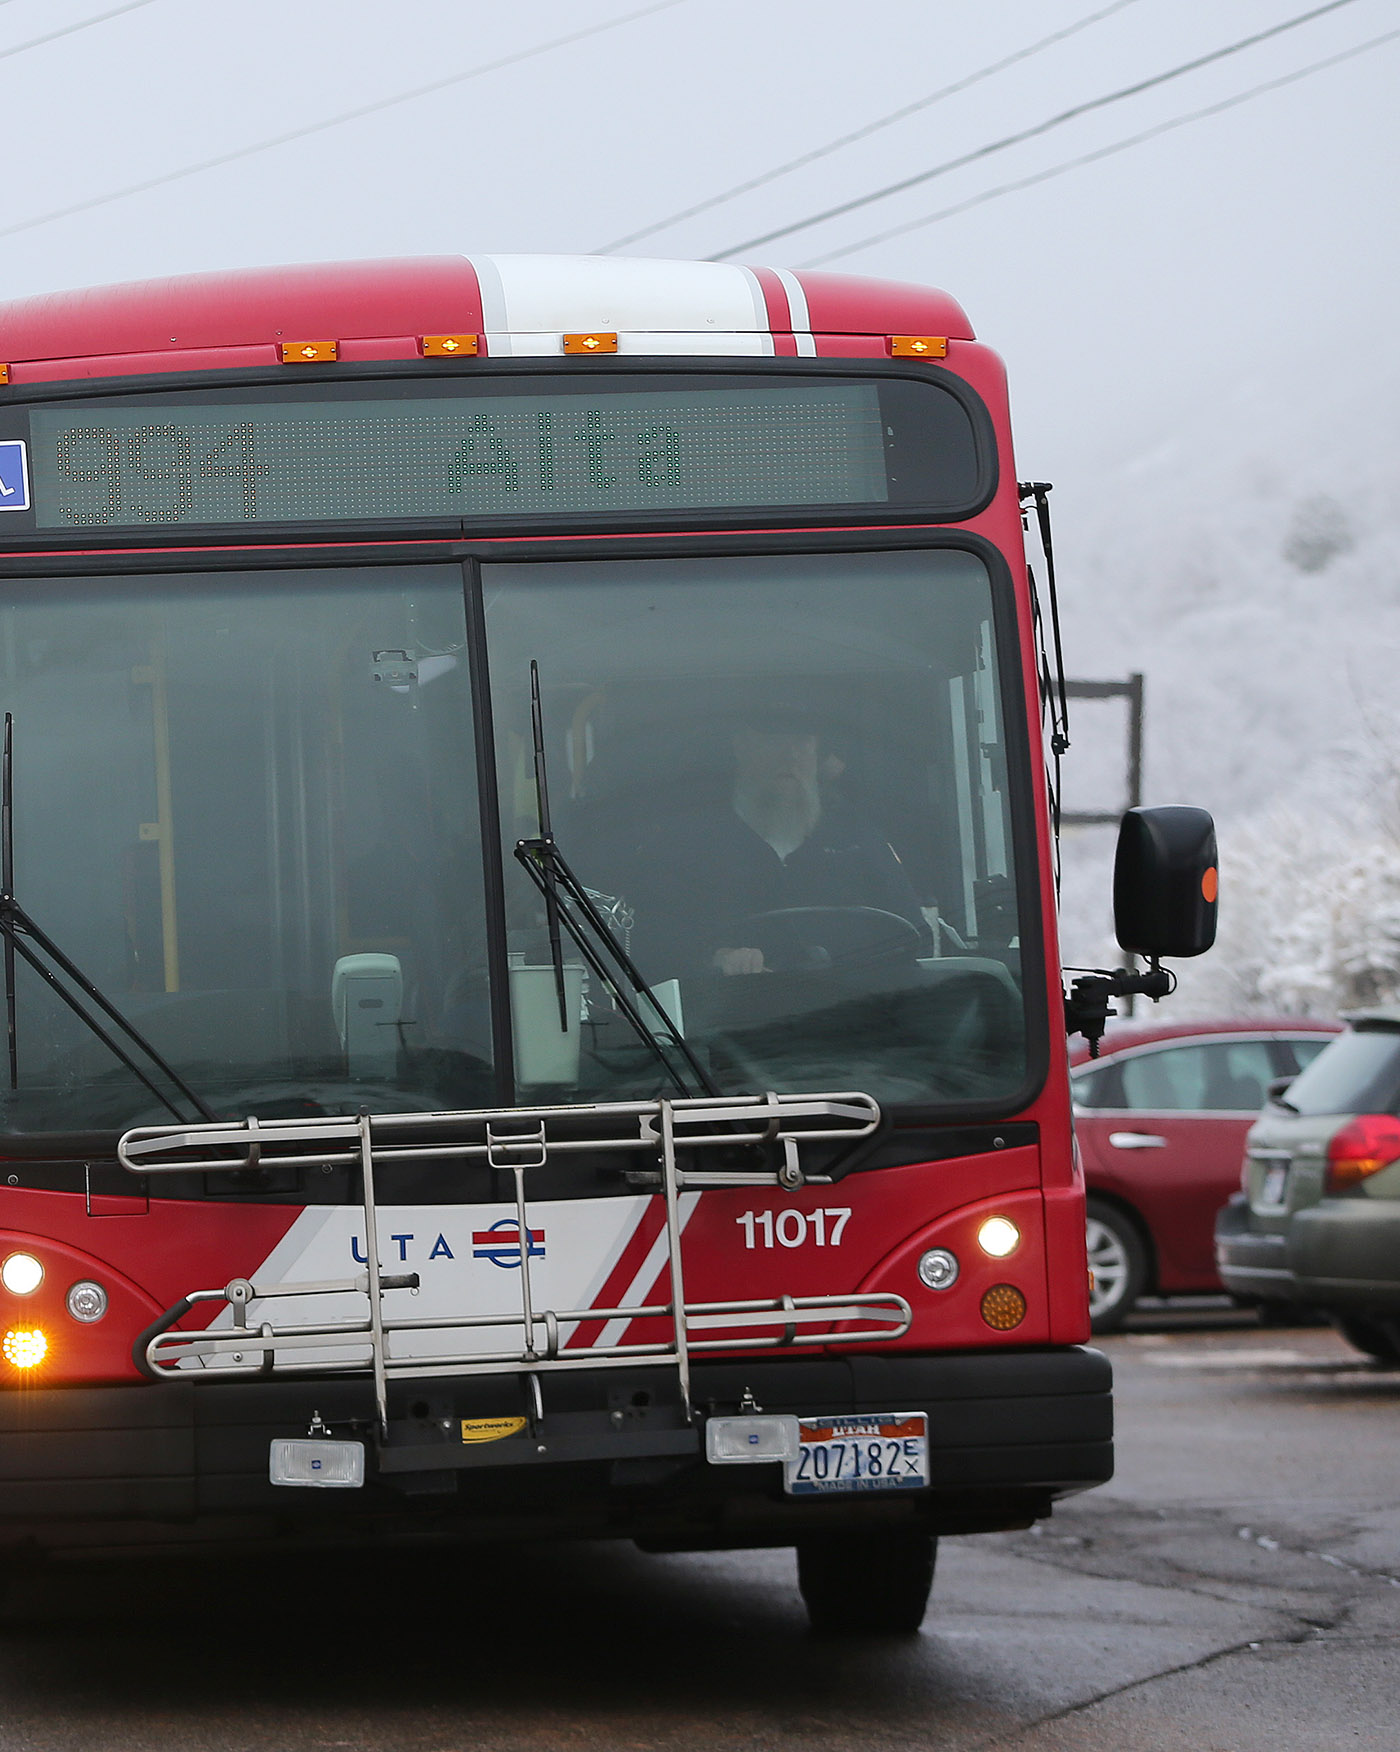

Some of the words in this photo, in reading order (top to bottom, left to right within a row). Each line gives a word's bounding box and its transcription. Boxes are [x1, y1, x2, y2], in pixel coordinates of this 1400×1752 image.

[56, 421, 271, 525] 994
[448, 410, 681, 494] Alta
[736, 1207, 852, 1249] 11017
[351, 1233, 455, 1263] UTA
[832, 1424, 881, 1437] UTAH
[796, 1442, 901, 1481] 207182
[856, 1480, 869, 1489] IN
[872, 1478, 896, 1488] USA
